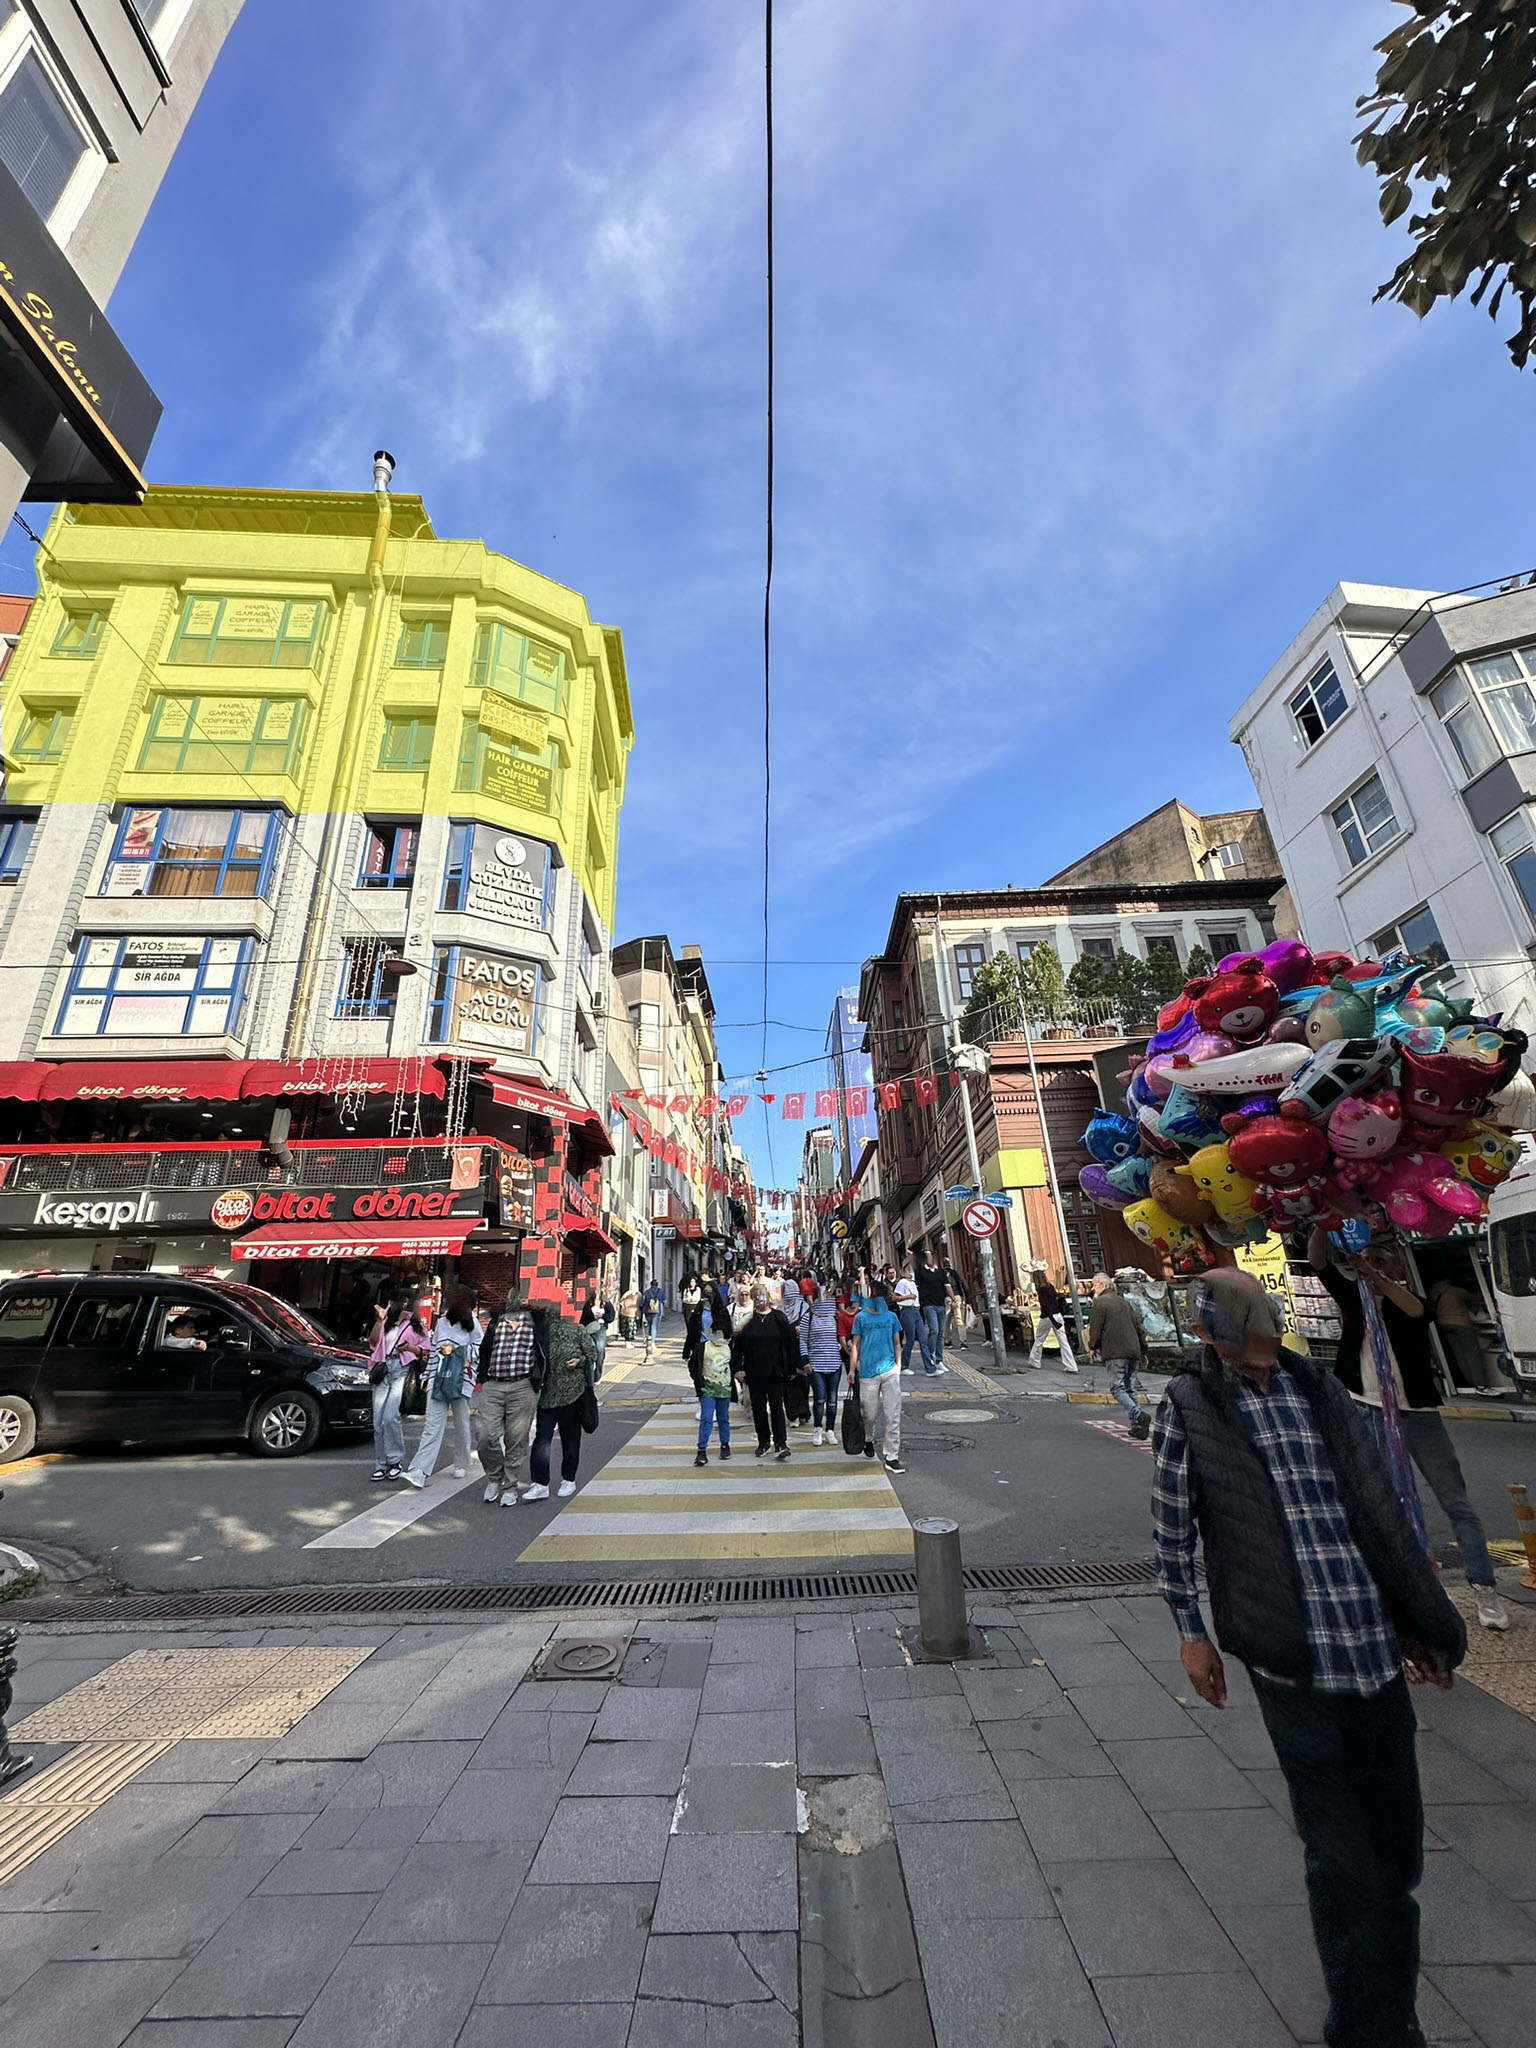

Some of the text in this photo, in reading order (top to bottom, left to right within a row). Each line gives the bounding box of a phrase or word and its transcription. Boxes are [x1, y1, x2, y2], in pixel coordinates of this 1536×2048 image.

[21, 292, 101, 406] Salonu
[484, 703, 546, 735] KİRALIK
[512, 760, 550, 780] GARAGE
[129, 942, 164, 952] FATOŞ
[134, 971, 181, 981] SİR AĞDA
[462, 956, 535, 995] FATOŞ
[469, 989, 521, 1012] AĞDA
[459, 1002, 530, 1028] SALONU
[77, 1085, 188, 1095] bitat döner
[282, 1081, 388, 1091] bitat döner
[517, 1097, 568, 1118] bitat döner
[33, 1192, 157, 1230] keşaplı
[252, 1187, 460, 1219] bitat döner
[243, 1243, 379, 1257] bitat döner
